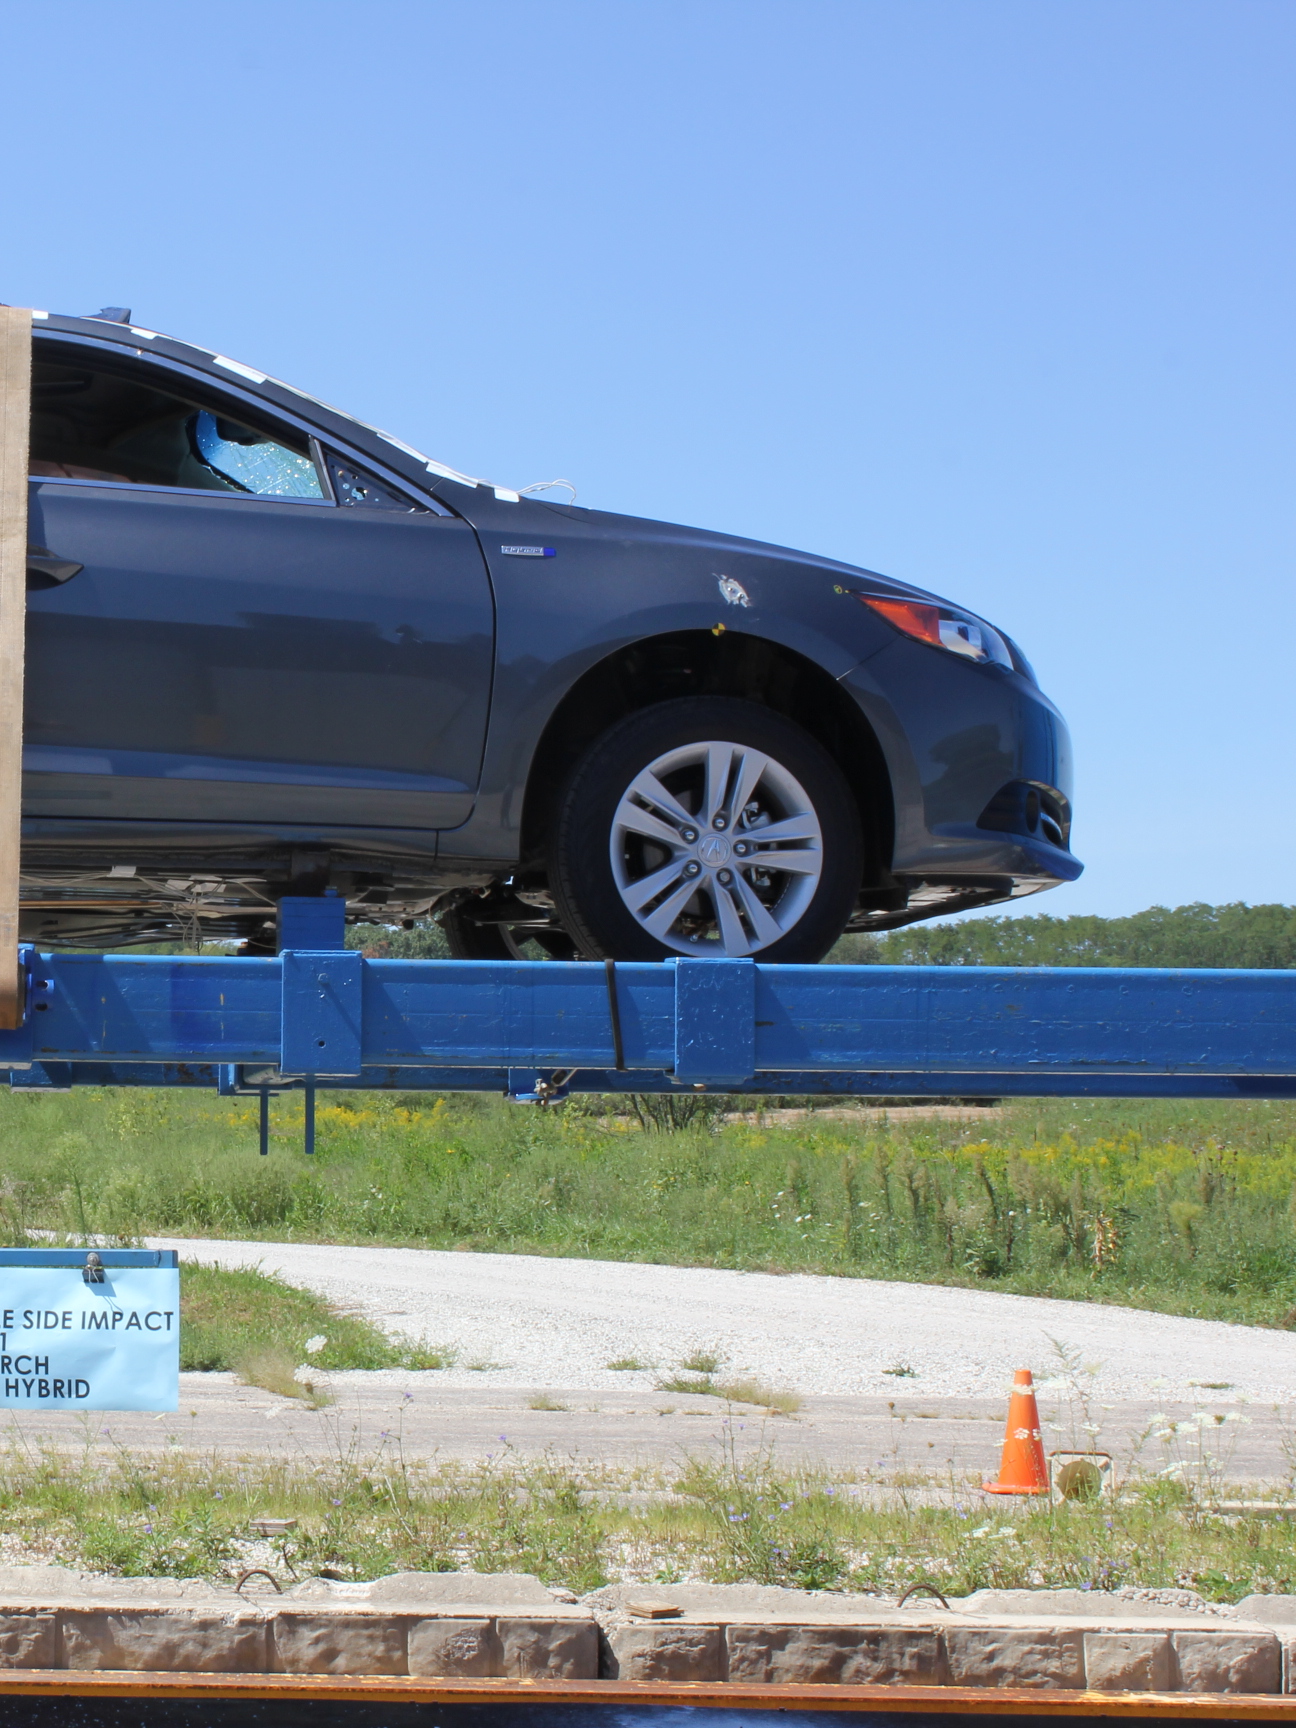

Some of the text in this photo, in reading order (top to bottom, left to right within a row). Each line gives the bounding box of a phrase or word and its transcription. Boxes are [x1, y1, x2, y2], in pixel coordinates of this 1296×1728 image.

[22, 1309, 72, 1330] SIDE
[81, 1311, 174, 1331] IMPACT
[5, 1377, 90, 1399] HYBRID
